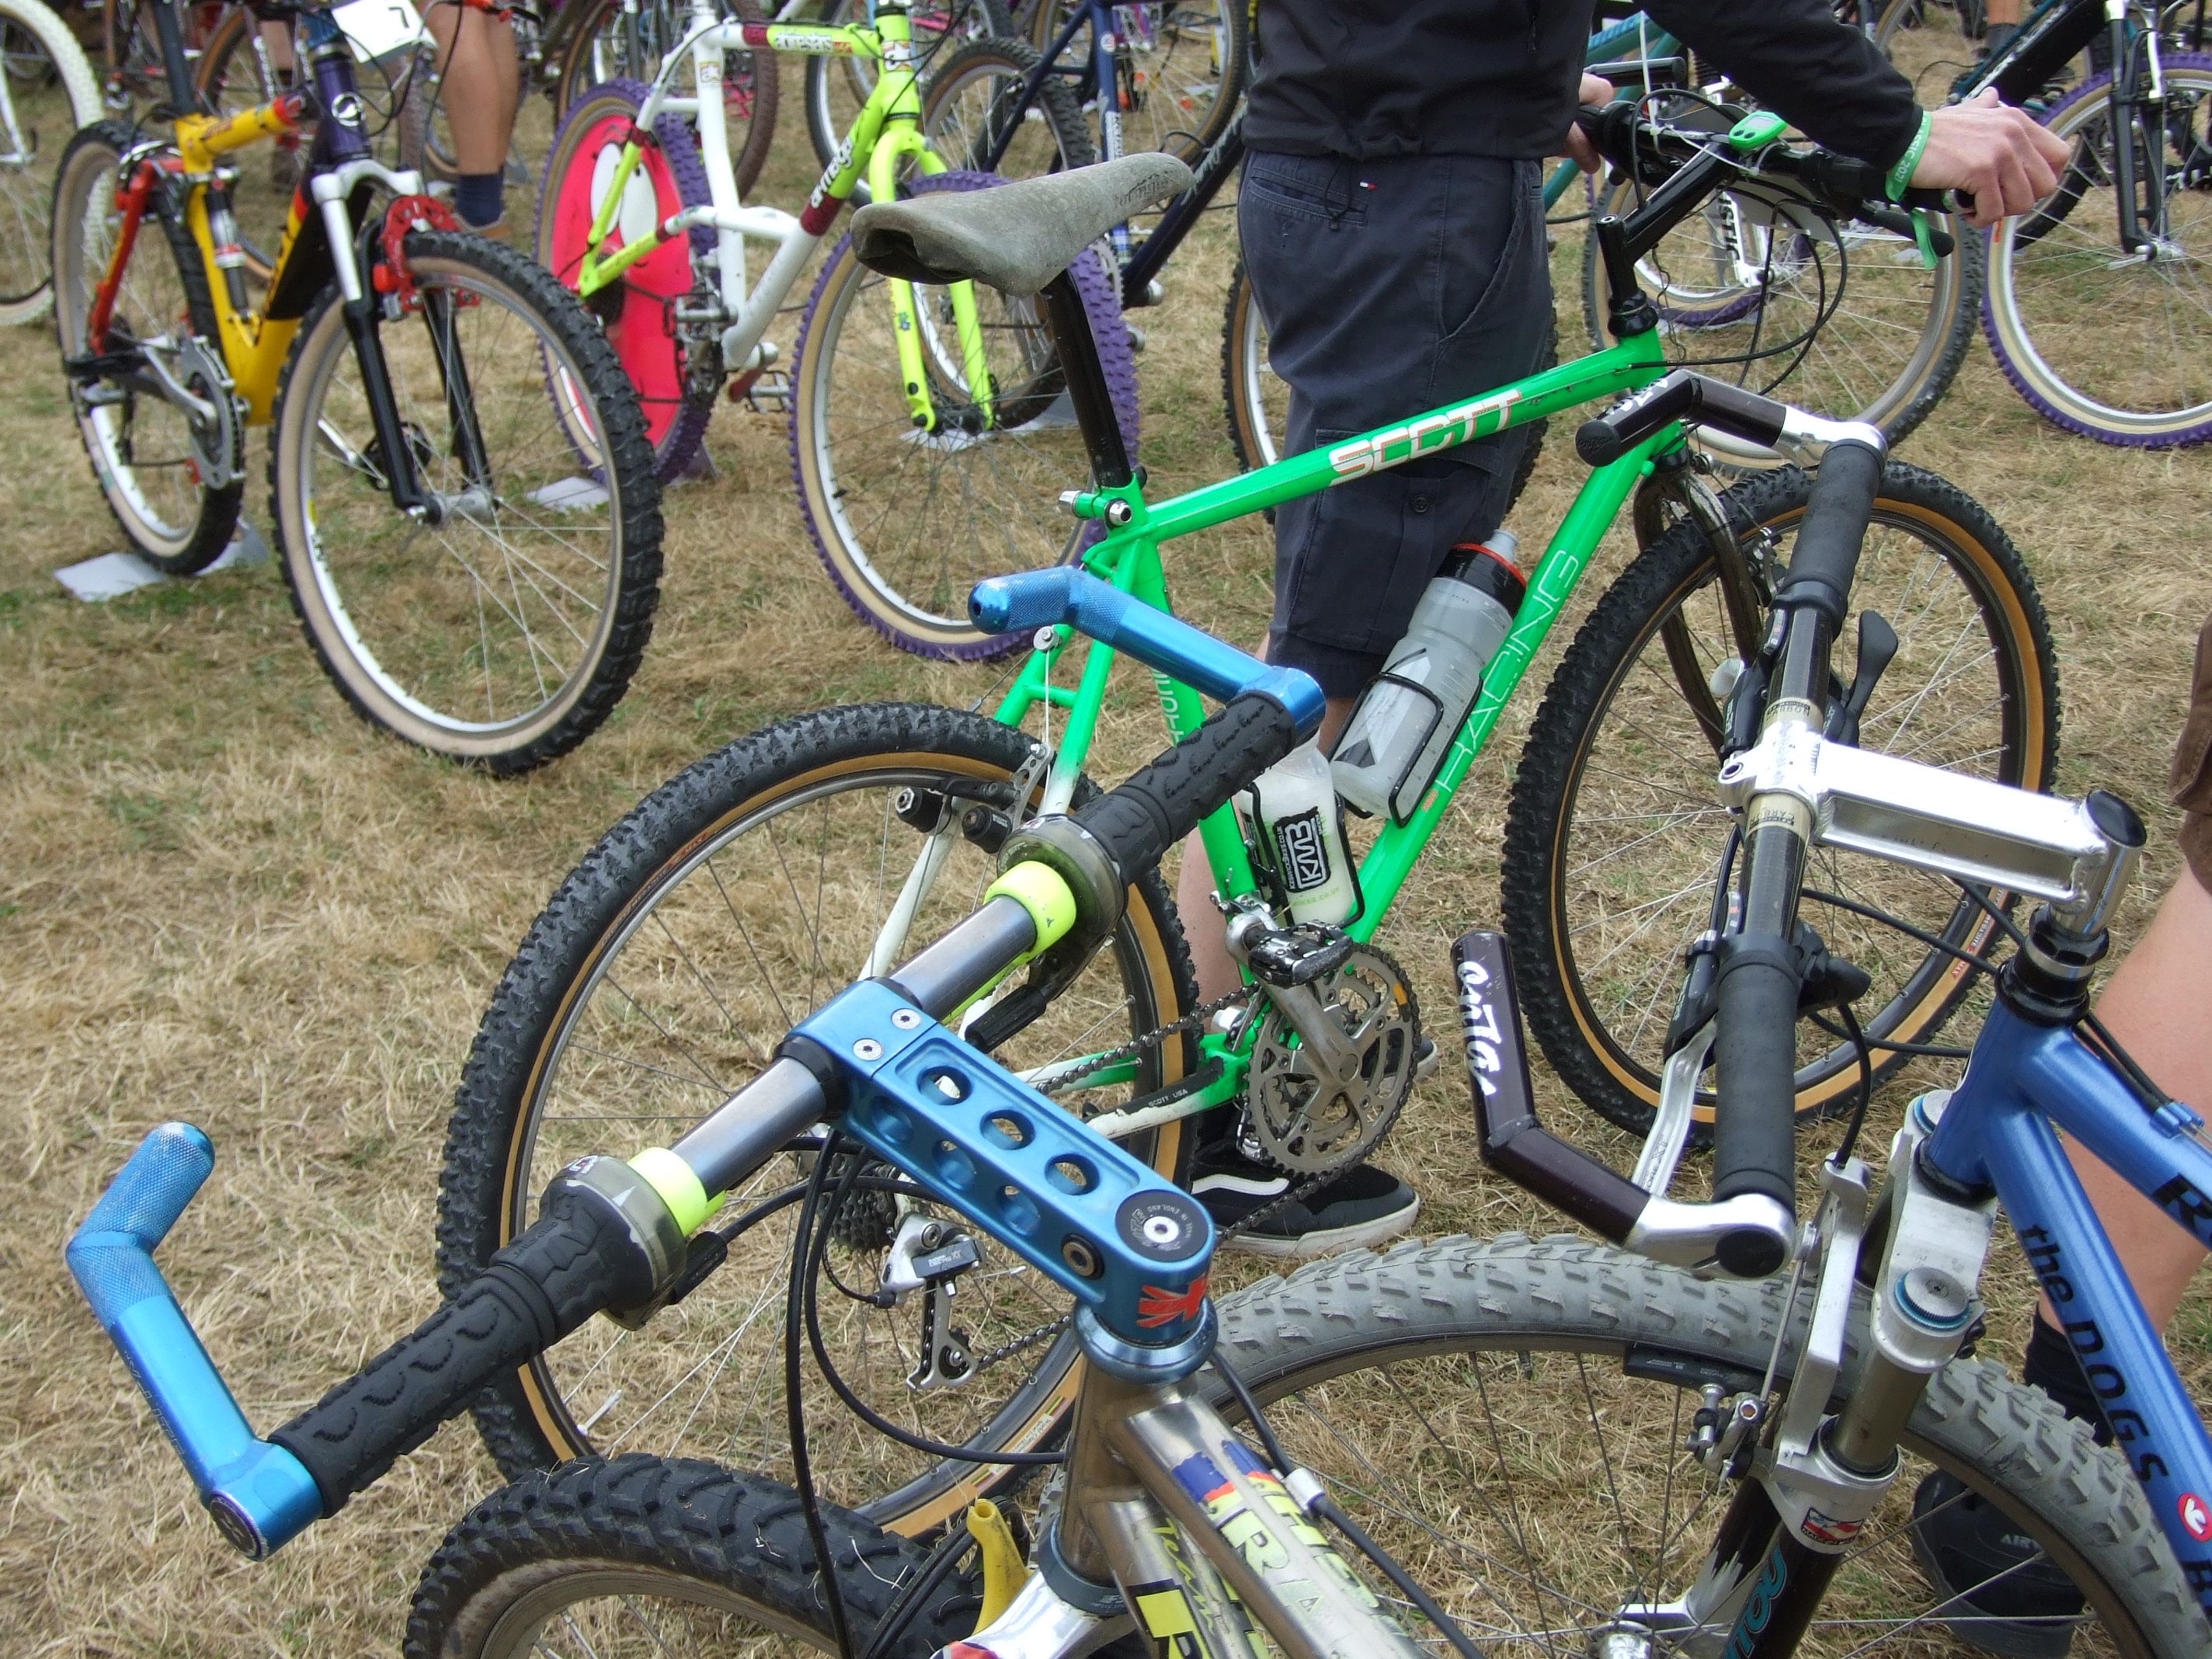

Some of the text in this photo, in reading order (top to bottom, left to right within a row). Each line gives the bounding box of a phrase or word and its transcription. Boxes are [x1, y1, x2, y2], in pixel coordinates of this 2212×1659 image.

[1328, 389, 1522, 471] SCOTT
[1148, 1089, 1188, 1108] SCOTT USA
[1146, 1204, 1181, 1215] ENGLAND
[2020, 1223, 2074, 1304] the
